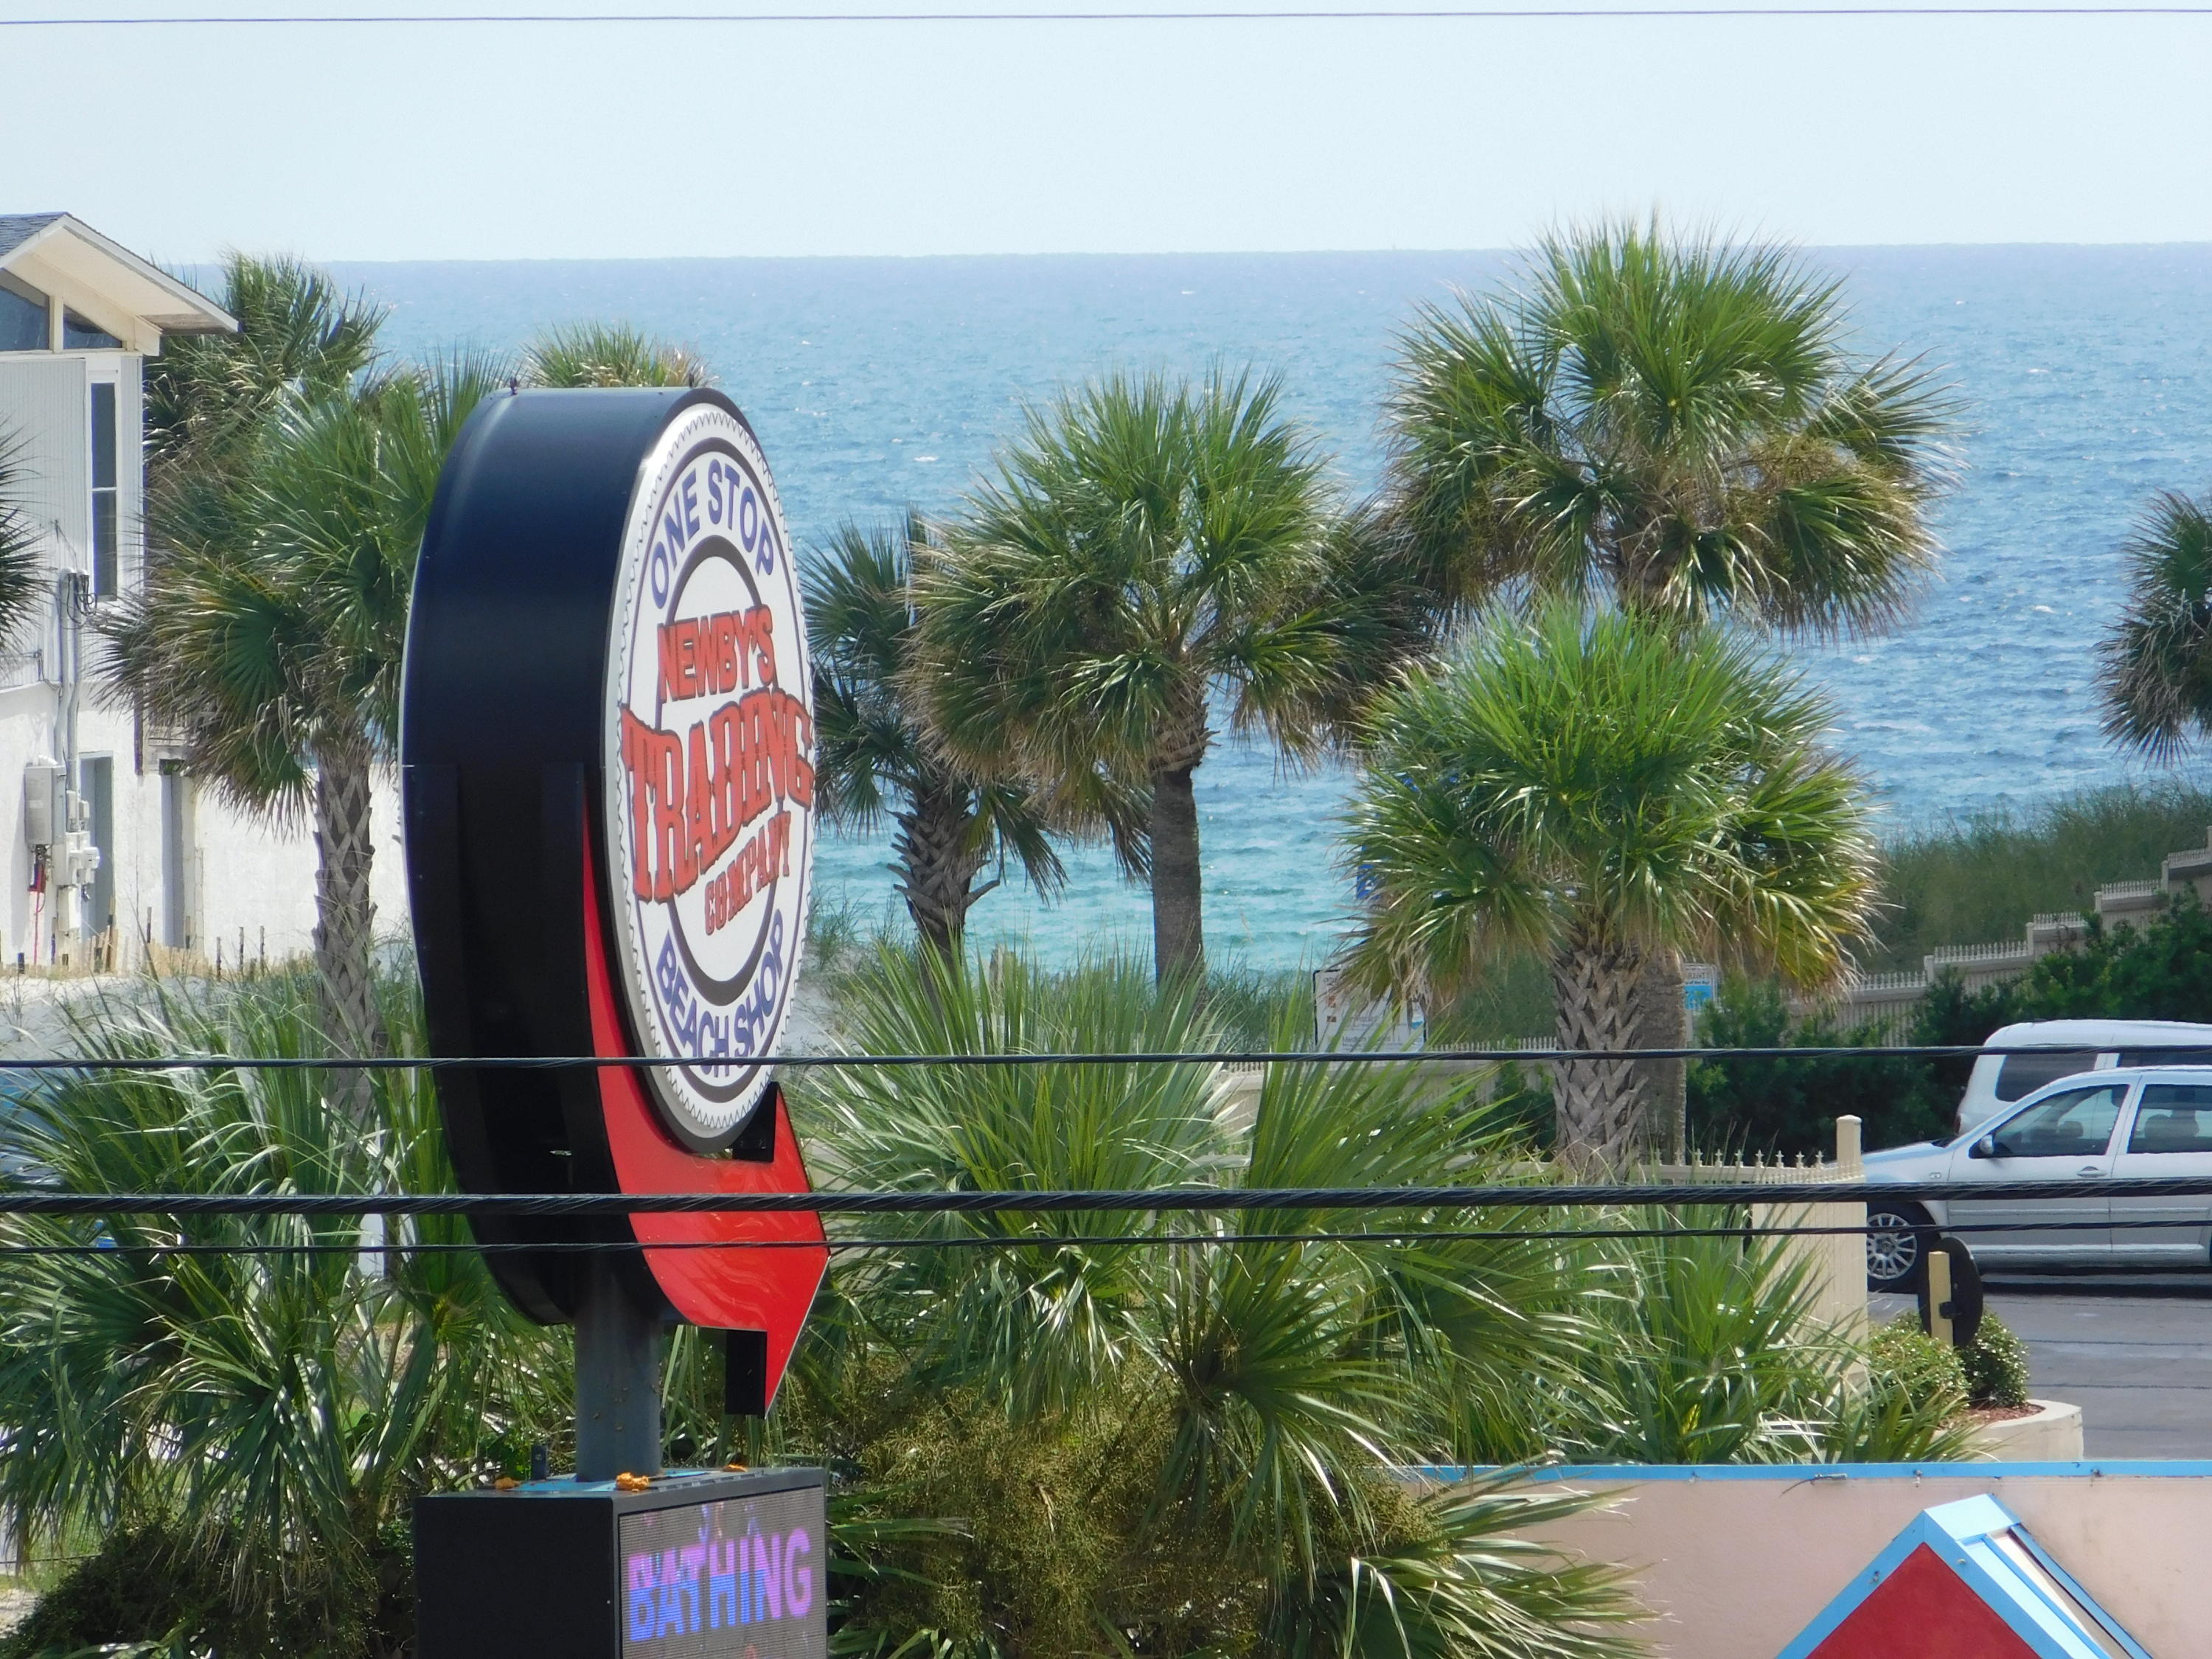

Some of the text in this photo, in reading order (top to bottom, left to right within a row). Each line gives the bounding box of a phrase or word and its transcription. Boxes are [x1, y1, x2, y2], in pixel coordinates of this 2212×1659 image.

[650, 459, 774, 609] ONE STOP
[657, 604, 775, 703] NEWBY'S
[620, 686, 815, 905] TRADING
[704, 810, 791, 936] COMPANY
[655, 908, 783, 1078] BEACH SHOP
[627, 1527, 813, 1641] BATHING
